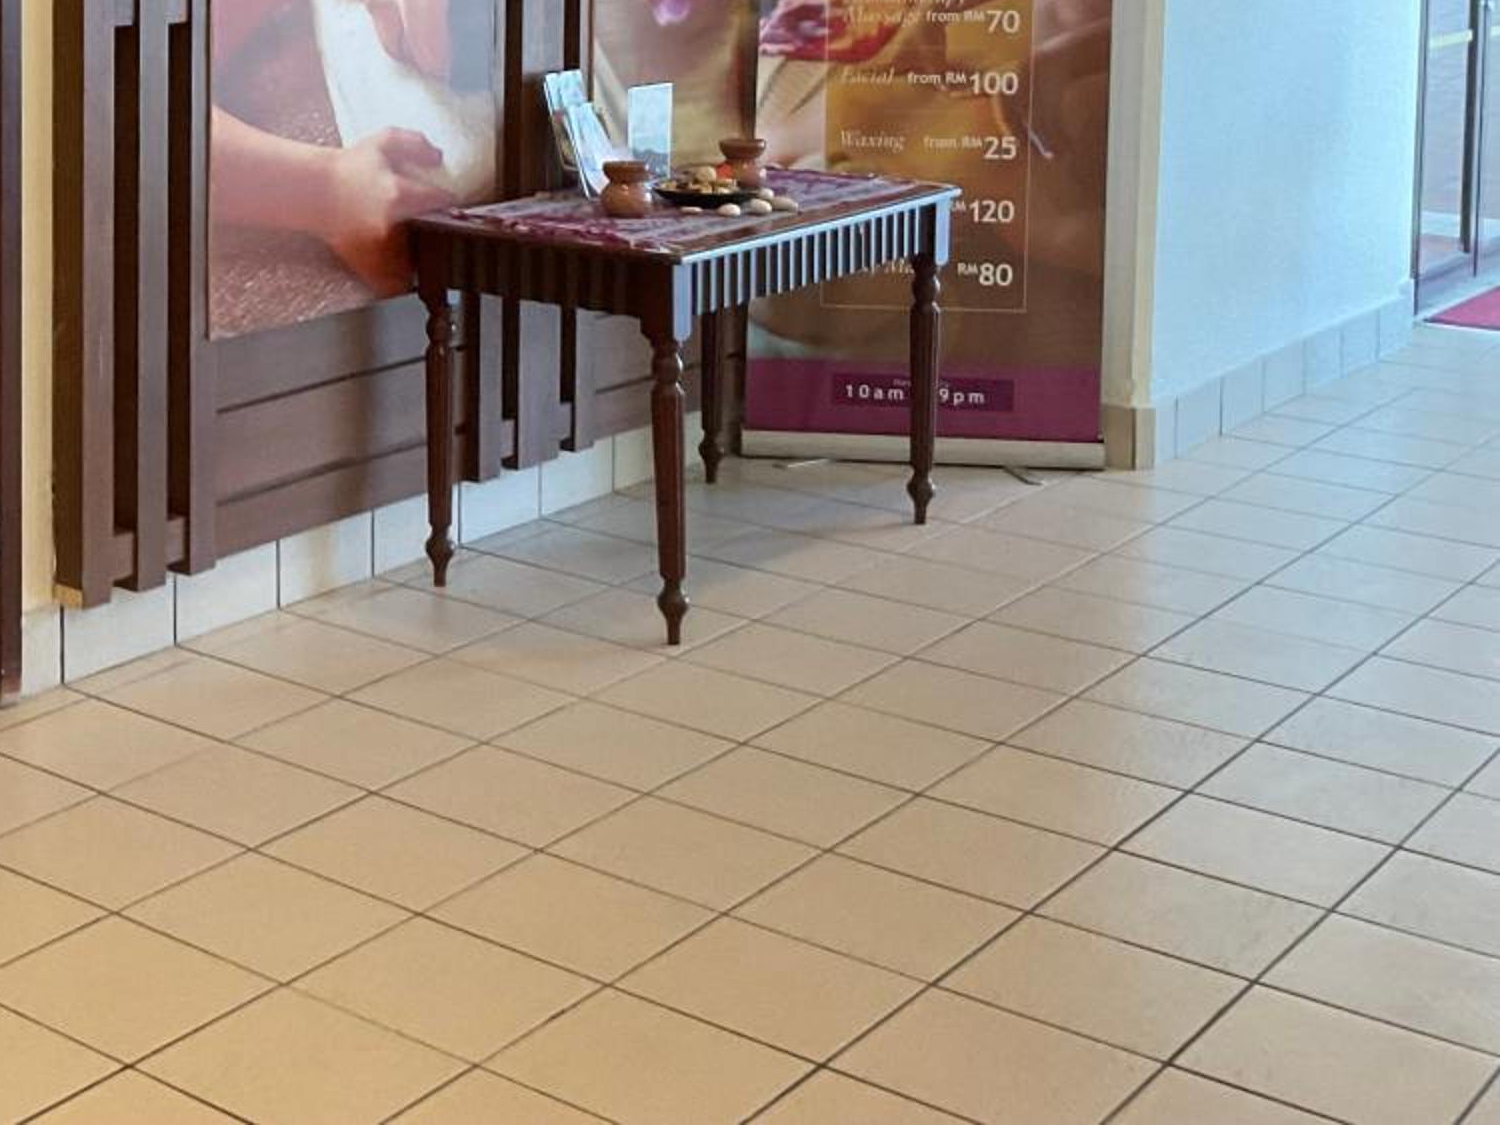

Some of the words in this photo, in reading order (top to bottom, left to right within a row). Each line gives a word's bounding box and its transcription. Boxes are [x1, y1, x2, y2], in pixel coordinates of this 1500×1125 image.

[926, 9, 960, 22] from
[907, 72, 942, 85] from
[841, 129, 906, 154] Waxing
[924, 136, 958, 148] from
